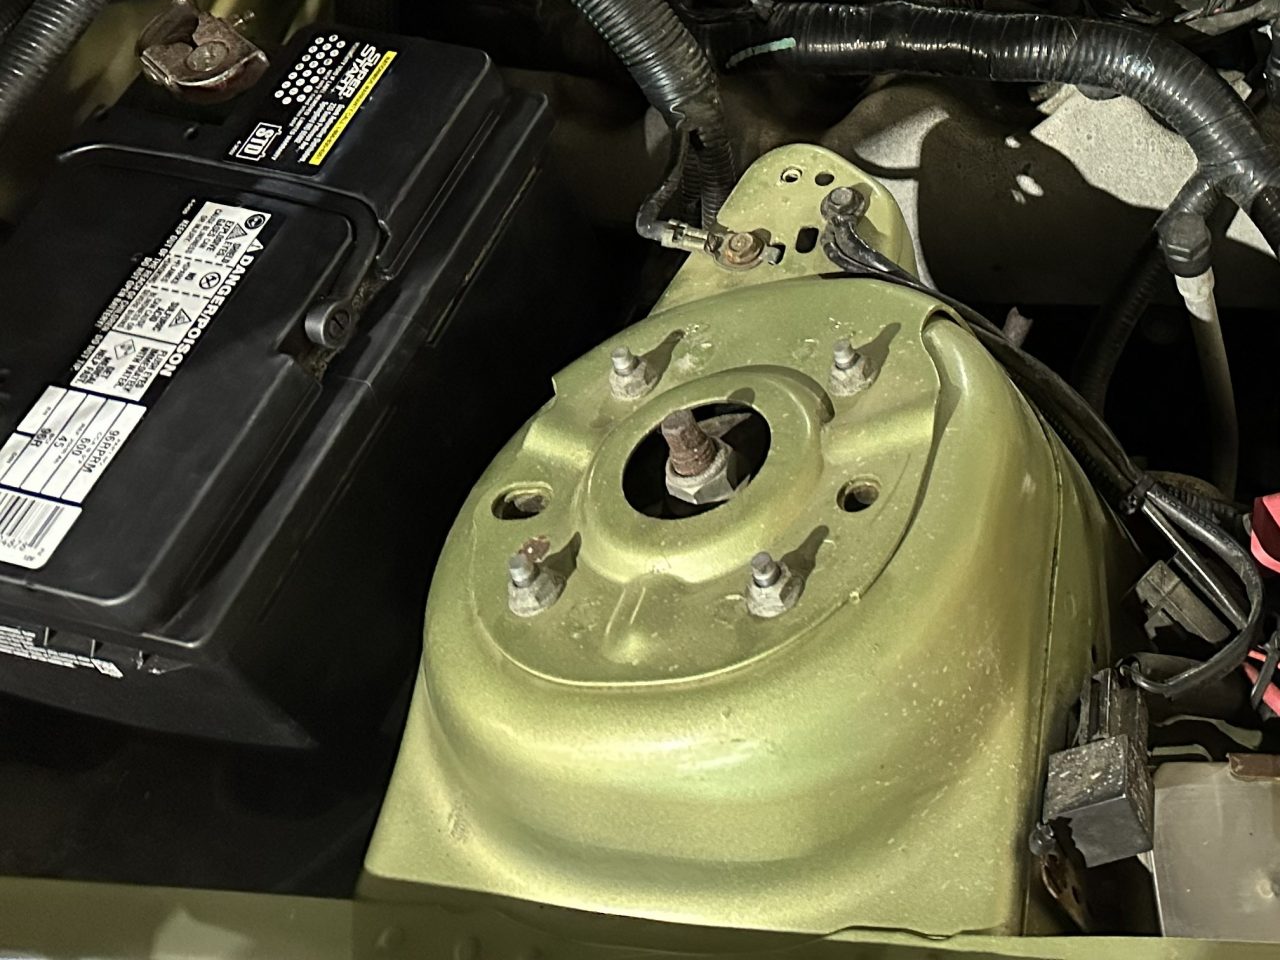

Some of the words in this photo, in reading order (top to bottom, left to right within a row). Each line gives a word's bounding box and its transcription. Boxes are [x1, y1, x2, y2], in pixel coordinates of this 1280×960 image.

[332, 44, 375, 96] START
[340, 51, 380, 97] SUPER
[244, 127, 274, 154] STD
[158, 254, 255, 379] DANGER/POISON
[30, 428, 51, 447] 96R
[53, 435, 67, 447] 45
[71, 437, 91, 456] 600
[83, 430, 119, 473] 96RPRM
